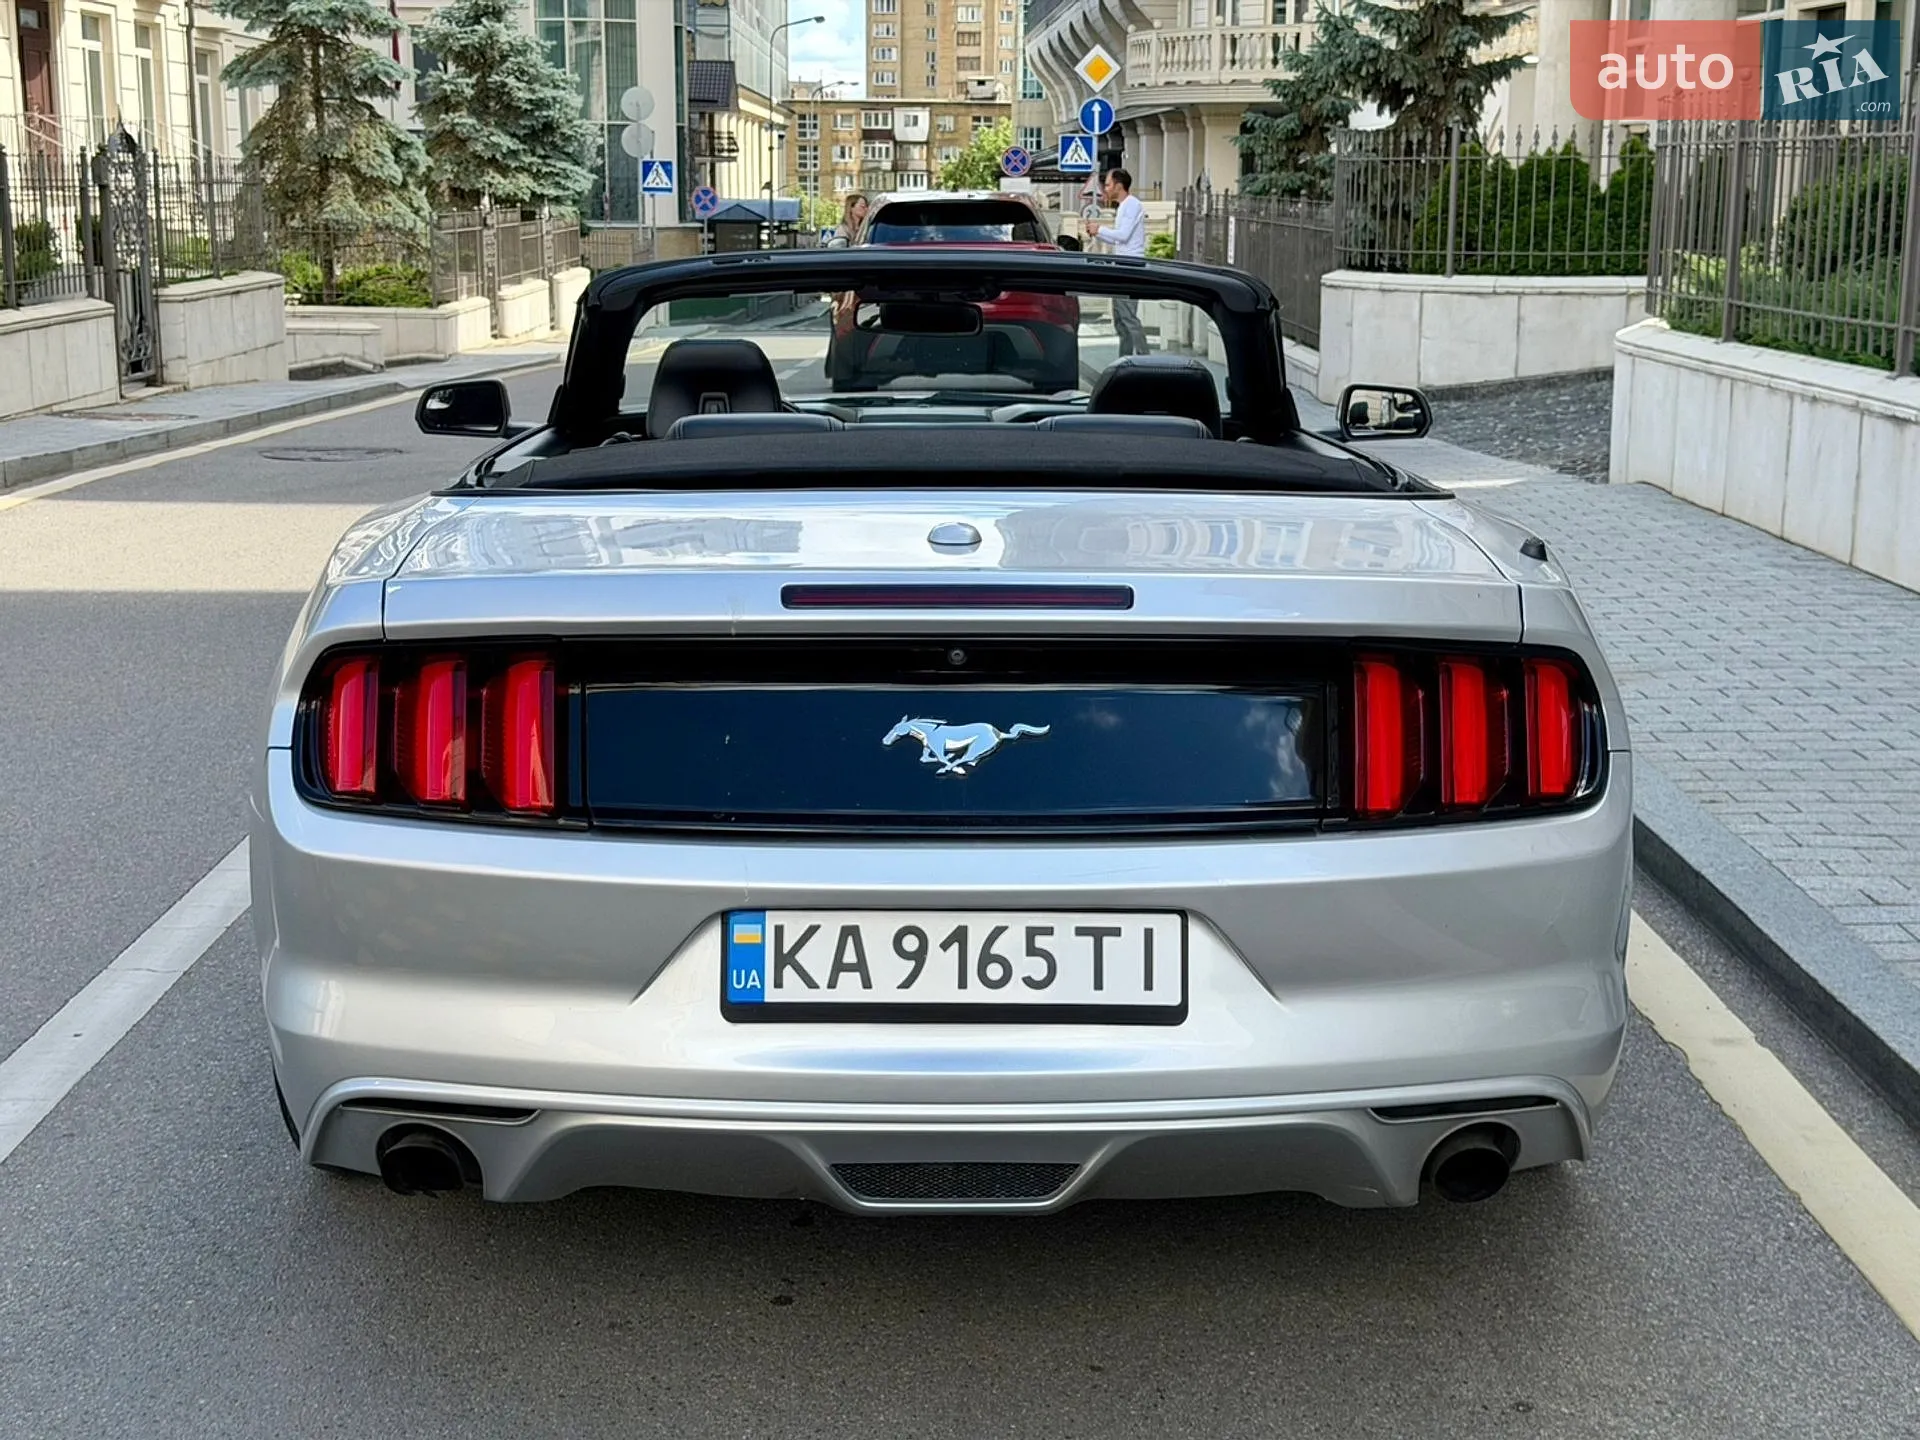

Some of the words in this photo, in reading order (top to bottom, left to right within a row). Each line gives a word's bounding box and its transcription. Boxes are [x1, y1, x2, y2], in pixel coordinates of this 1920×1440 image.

[772, 924, 873, 990] KA
[892, 924, 1057, 990] 9165
[1074, 926, 1154, 991] TI
[732, 970, 762, 989] UA
